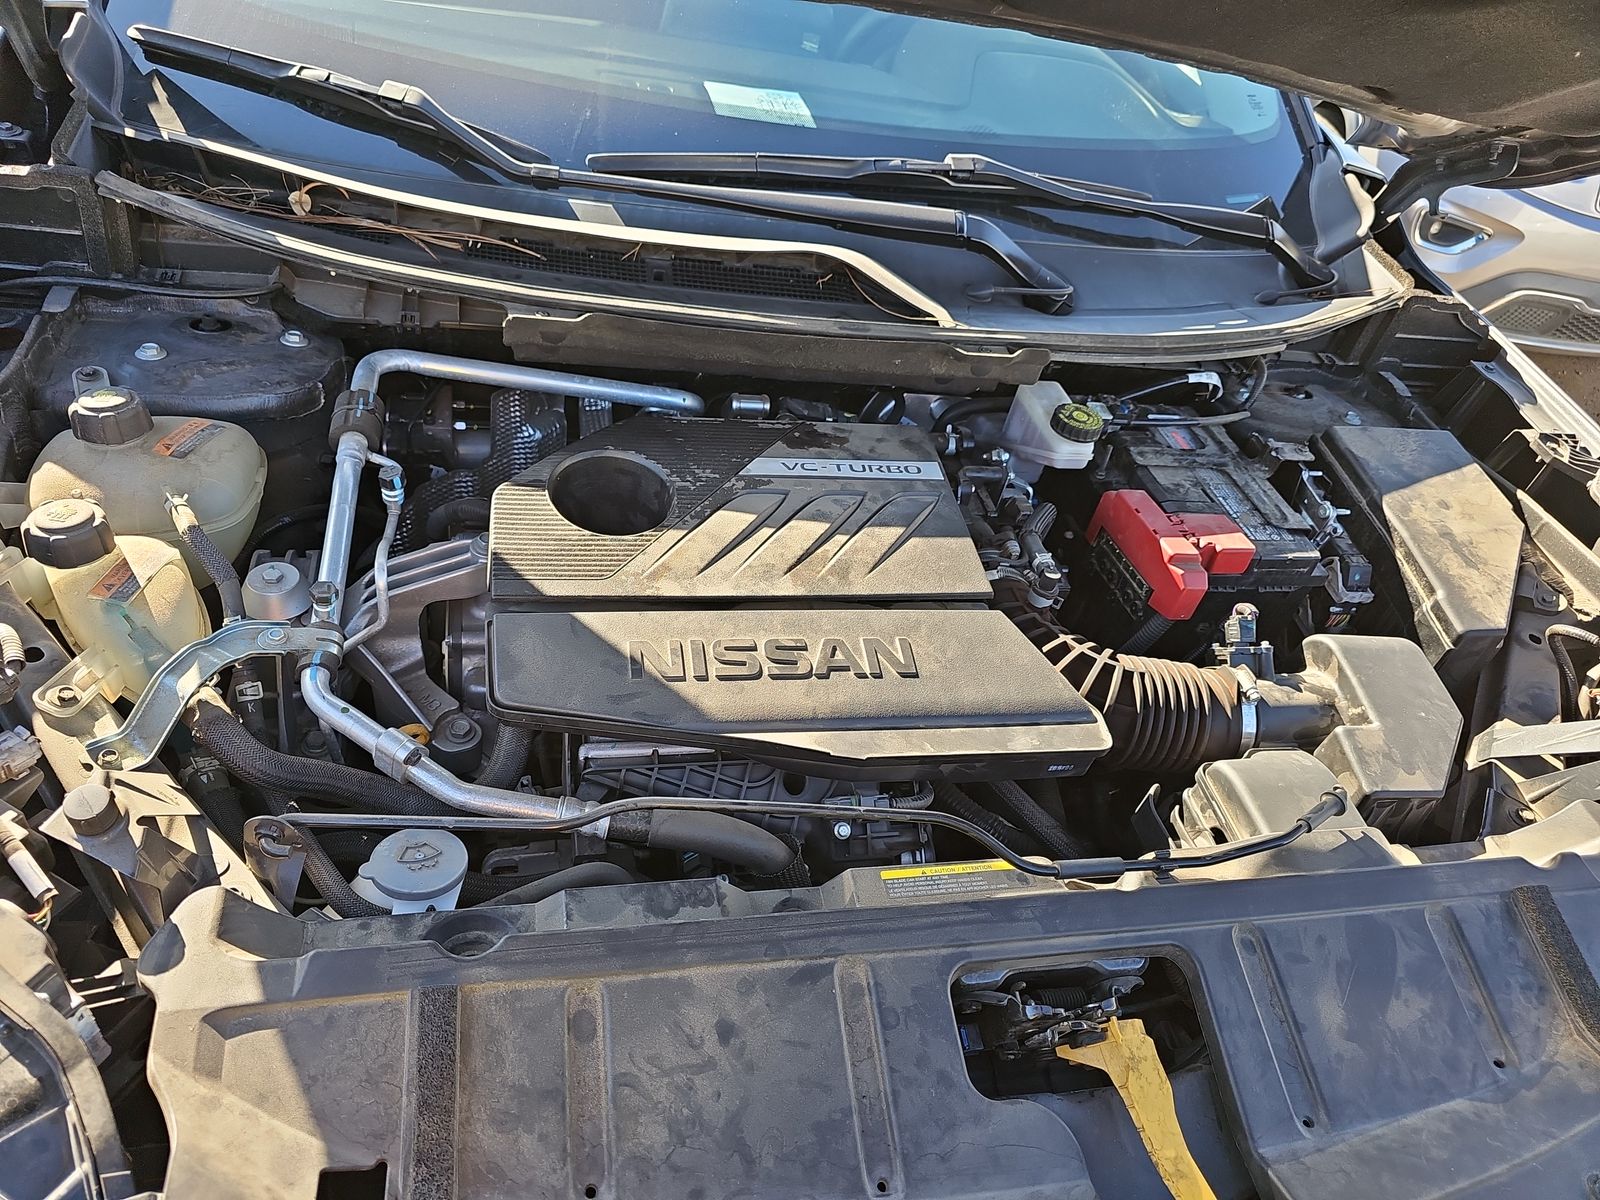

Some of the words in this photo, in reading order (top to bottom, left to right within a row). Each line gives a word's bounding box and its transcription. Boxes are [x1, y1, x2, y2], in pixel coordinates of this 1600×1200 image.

[780, 462, 922, 474] VC-TURBO
[628, 637, 919, 682] NISSAN
[961, 864, 993, 872] ATTENTION
